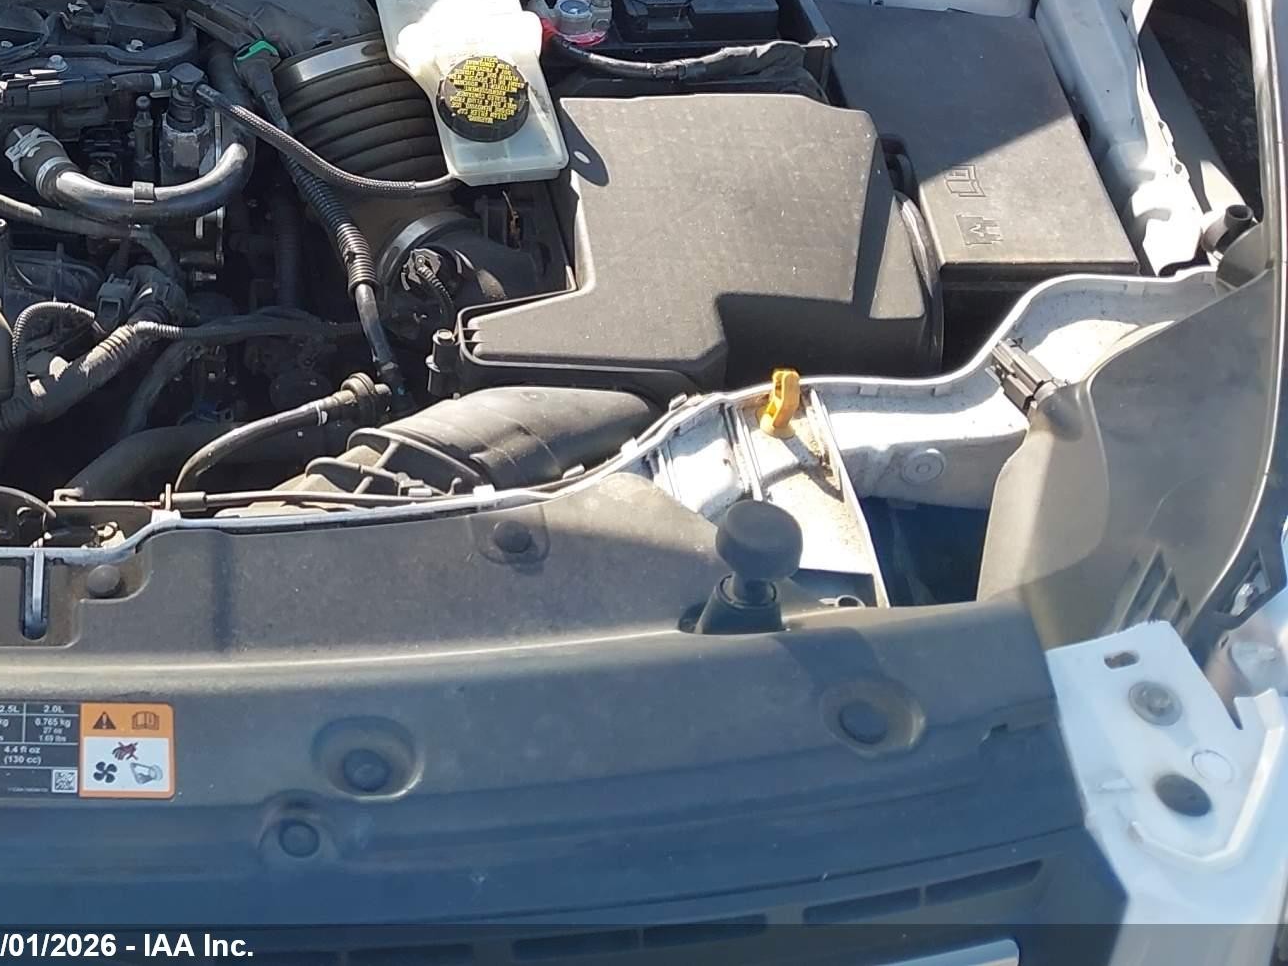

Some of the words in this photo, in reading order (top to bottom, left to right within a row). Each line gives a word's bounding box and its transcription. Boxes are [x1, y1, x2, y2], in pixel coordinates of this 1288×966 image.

[0, 704, 20, 713] 2.5L
[43, 705, 64, 713] 2.0L
[34, 718, 58, 726] 0.765
[60, 718, 71, 728] kg
[4, 746, 18, 754] 4.4
[4, 756, 25, 765] (130
[26, 757, 42, 765] cc)
